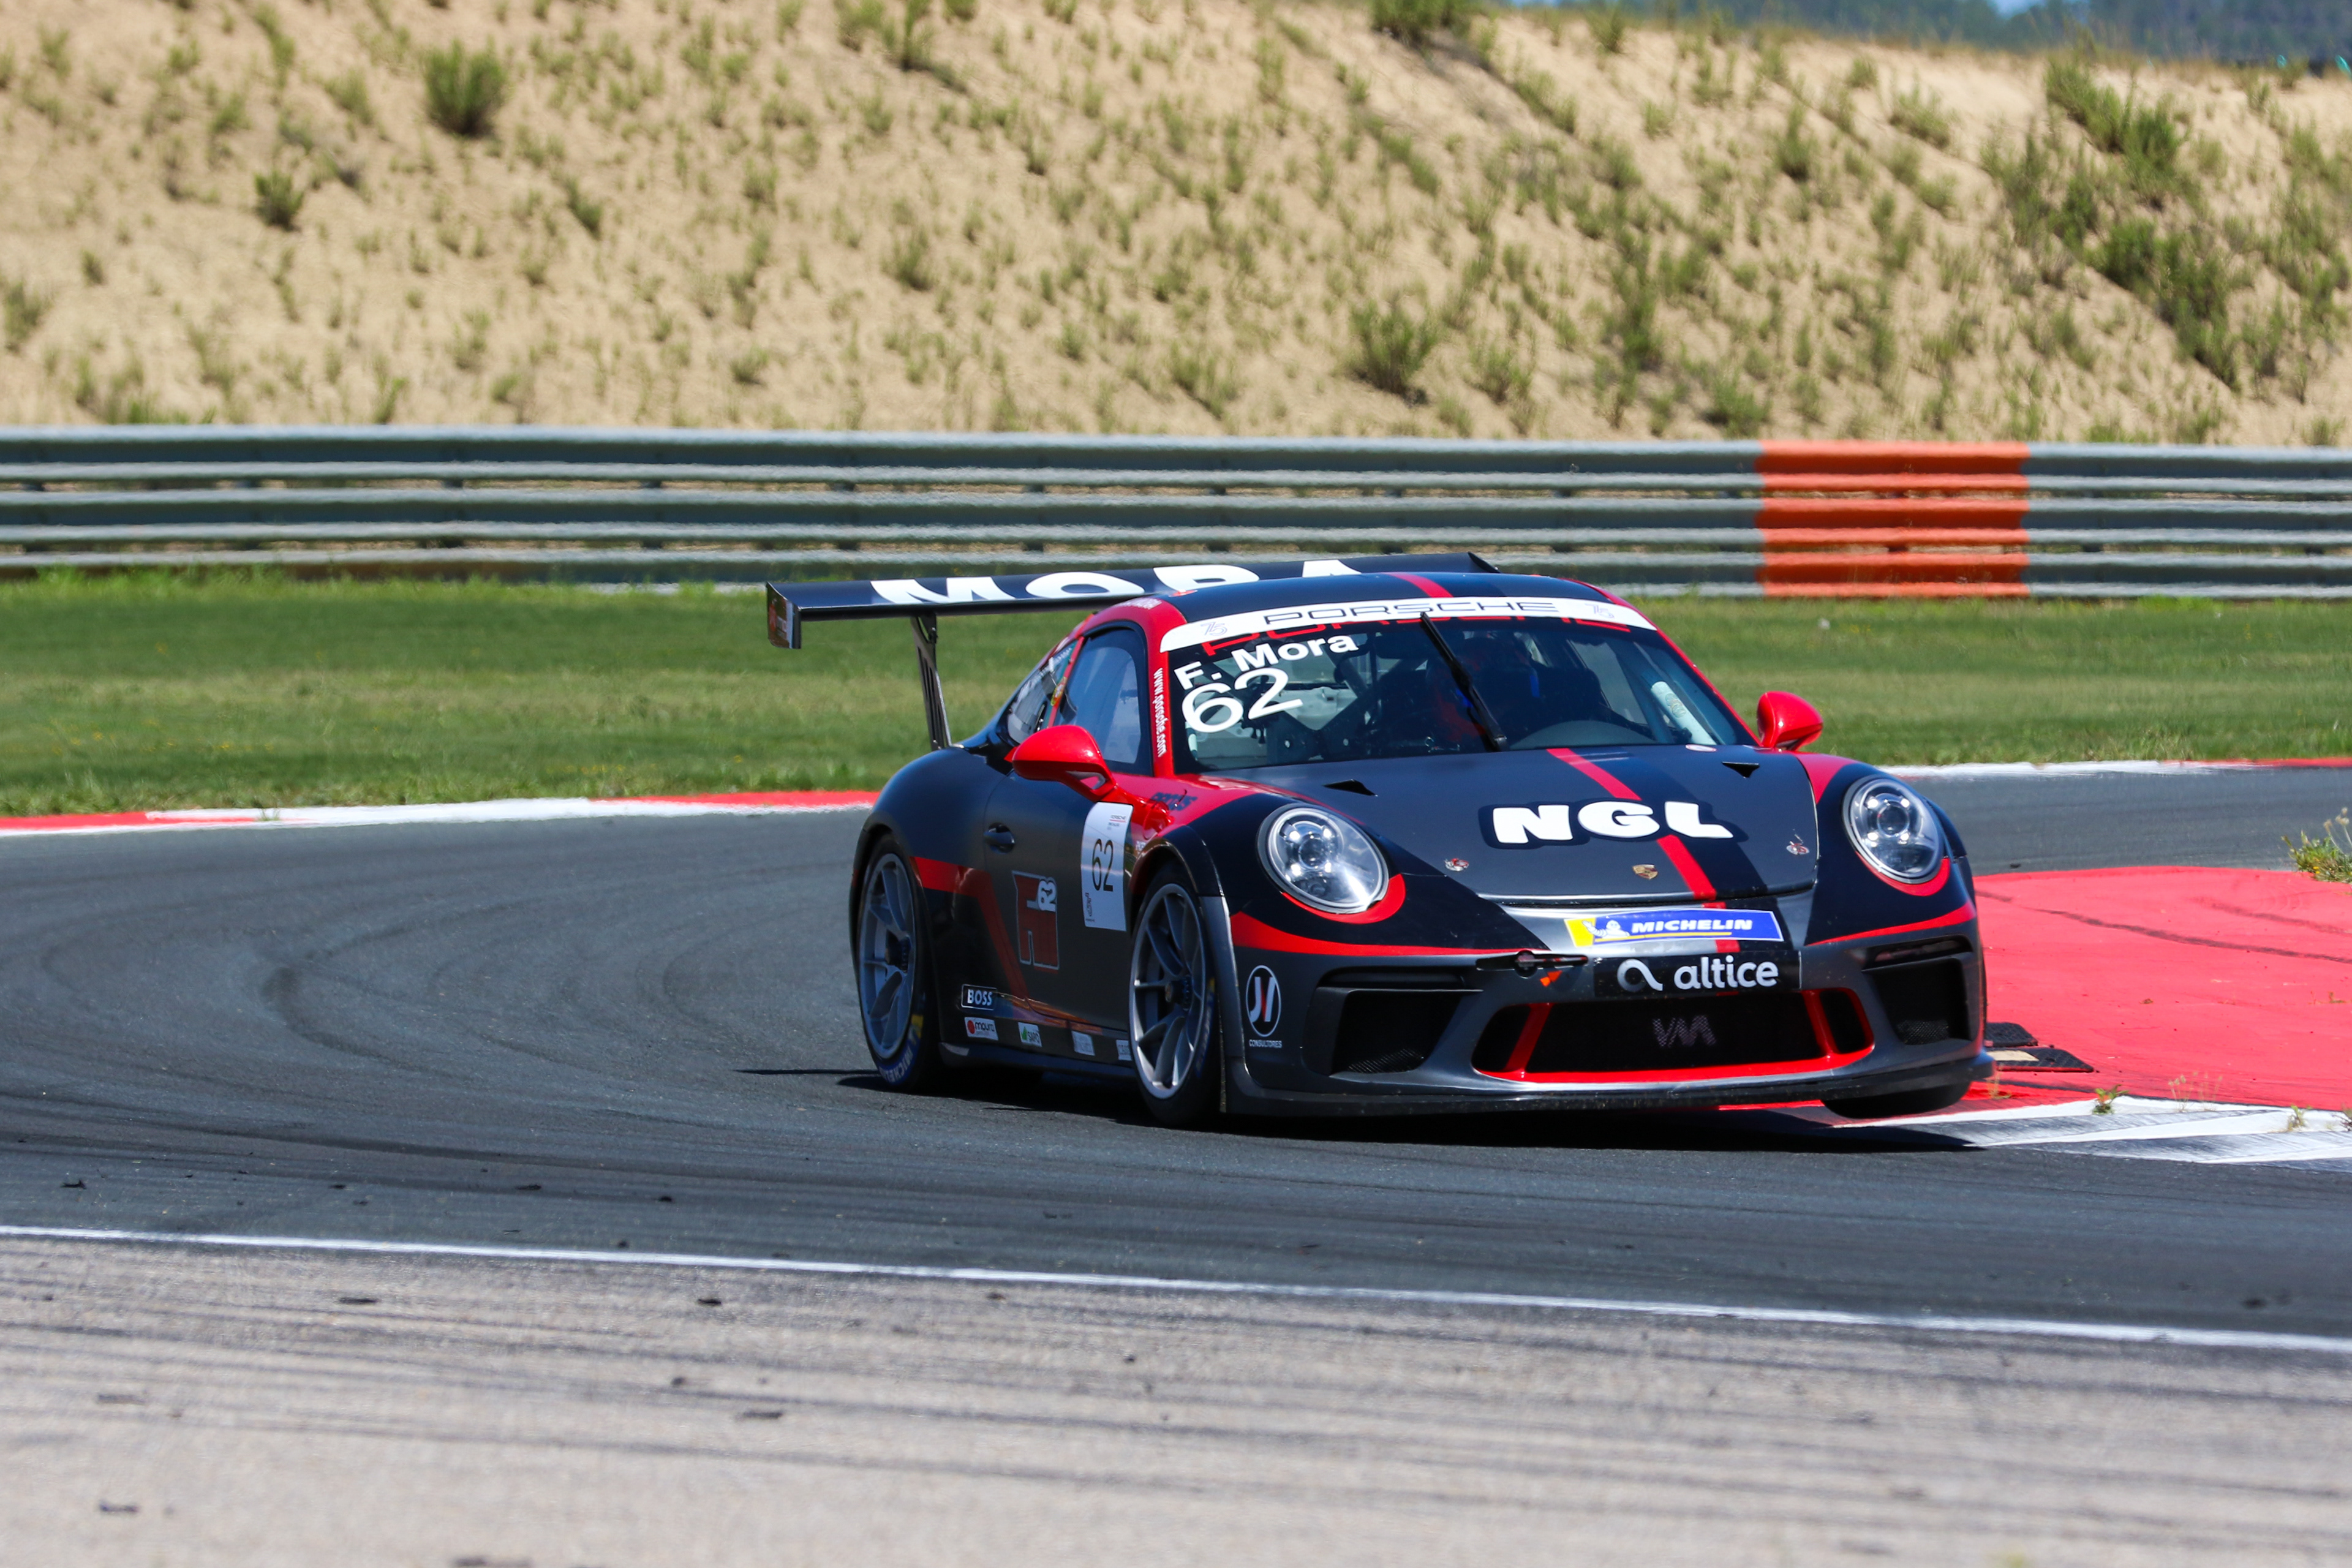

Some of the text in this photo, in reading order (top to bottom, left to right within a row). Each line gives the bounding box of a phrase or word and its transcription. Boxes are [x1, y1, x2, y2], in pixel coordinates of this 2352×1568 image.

[1264, 601, 1559, 625] PORSCHE
[1175, 662, 1222, 690] F.
[1232, 636, 1359, 671] Mora
[1153, 668, 1169, 758] www.porsche.com
[1182, 668, 1303, 734] 62
[1492, 801, 1733, 844] NGL
[1092, 839, 1114, 892] 62
[1630, 918, 1753, 933] MICHELIN
[1673, 955, 1779, 990] altice
[967, 989, 993, 1006] BOSS
